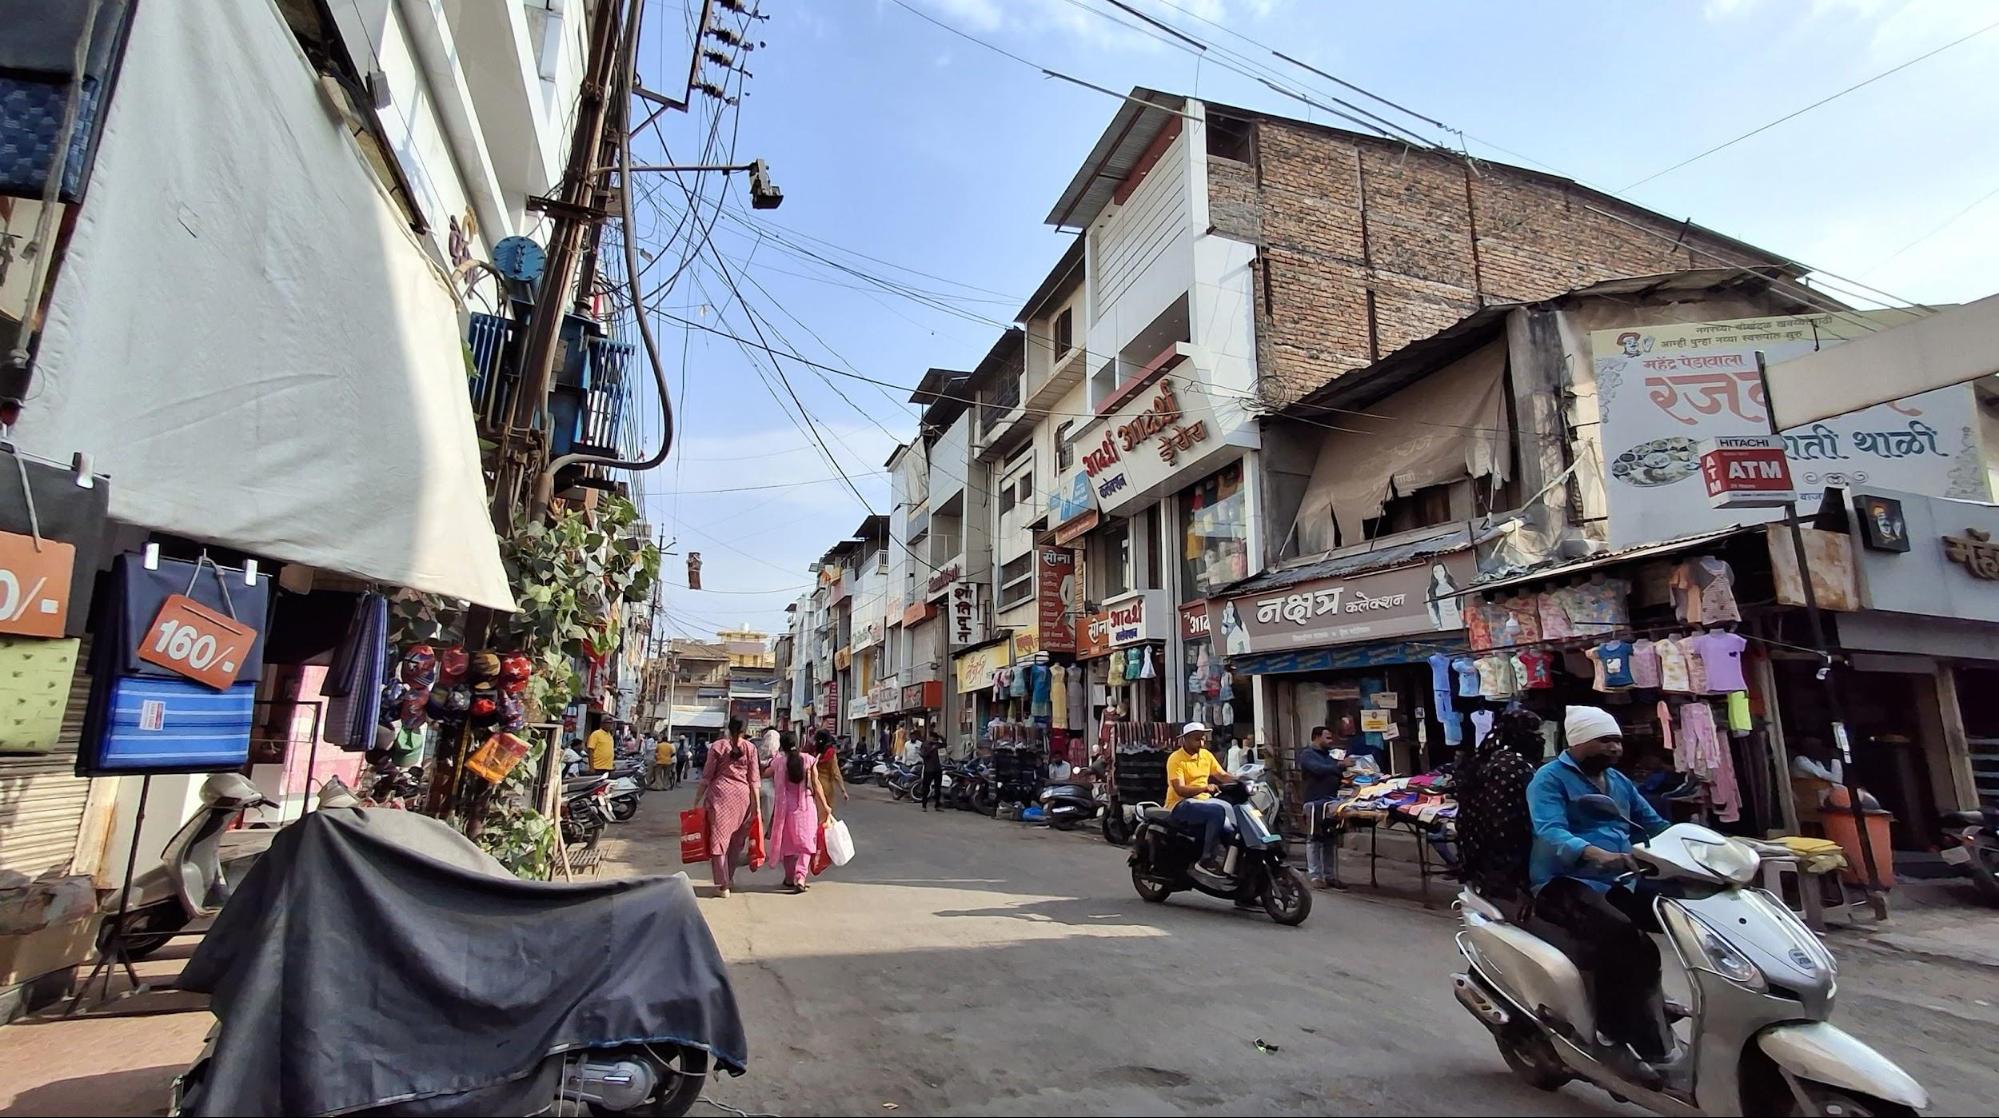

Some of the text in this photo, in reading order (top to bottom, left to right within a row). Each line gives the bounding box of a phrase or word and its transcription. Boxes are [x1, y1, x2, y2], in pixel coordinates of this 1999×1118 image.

[1660, 337, 1687, 348] आम्ही
[1690, 336, 1712, 349] पुन्हा
[1117, 378, 1183, 452] आदर्श
[1082, 429, 1121, 478] आदर्श
[1719, 439, 1770, 448] HITACHI
[1853, 420, 1949, 458] थाळी
[1706, 455, 1722, 494] ATM
[1728, 460, 1783, 479] ATM
[1043, 549, 1071, 567] सोना
[1110, 599, 1143, 628] आदर्श
[1256, 587, 1407, 625] नक्षत्र कलेक्शन
[155, 619, 235, 673] 160/-
